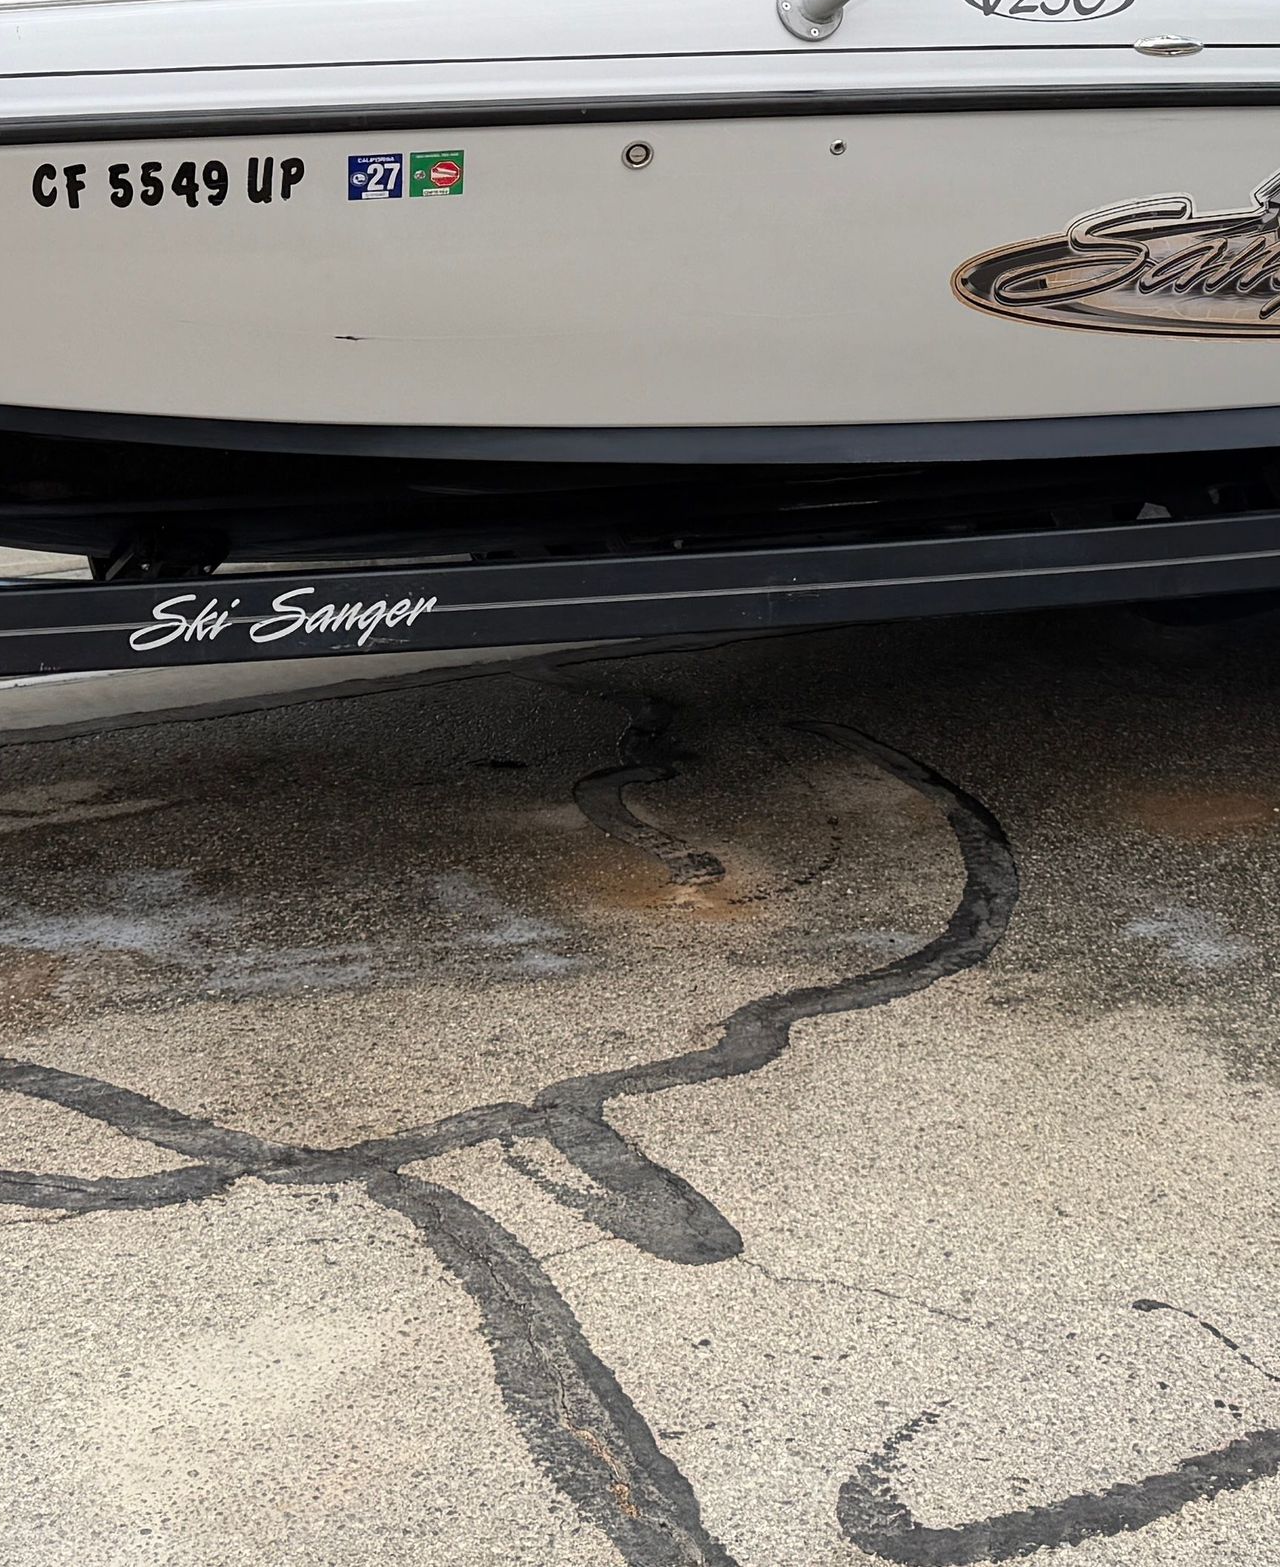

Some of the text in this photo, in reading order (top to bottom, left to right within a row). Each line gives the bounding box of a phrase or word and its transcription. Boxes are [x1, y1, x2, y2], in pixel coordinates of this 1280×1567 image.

[32, 157, 305, 209] CF 5549 UP
[366, 163, 401, 191] 27
[129, 586, 438, 651] Ski Sanger
